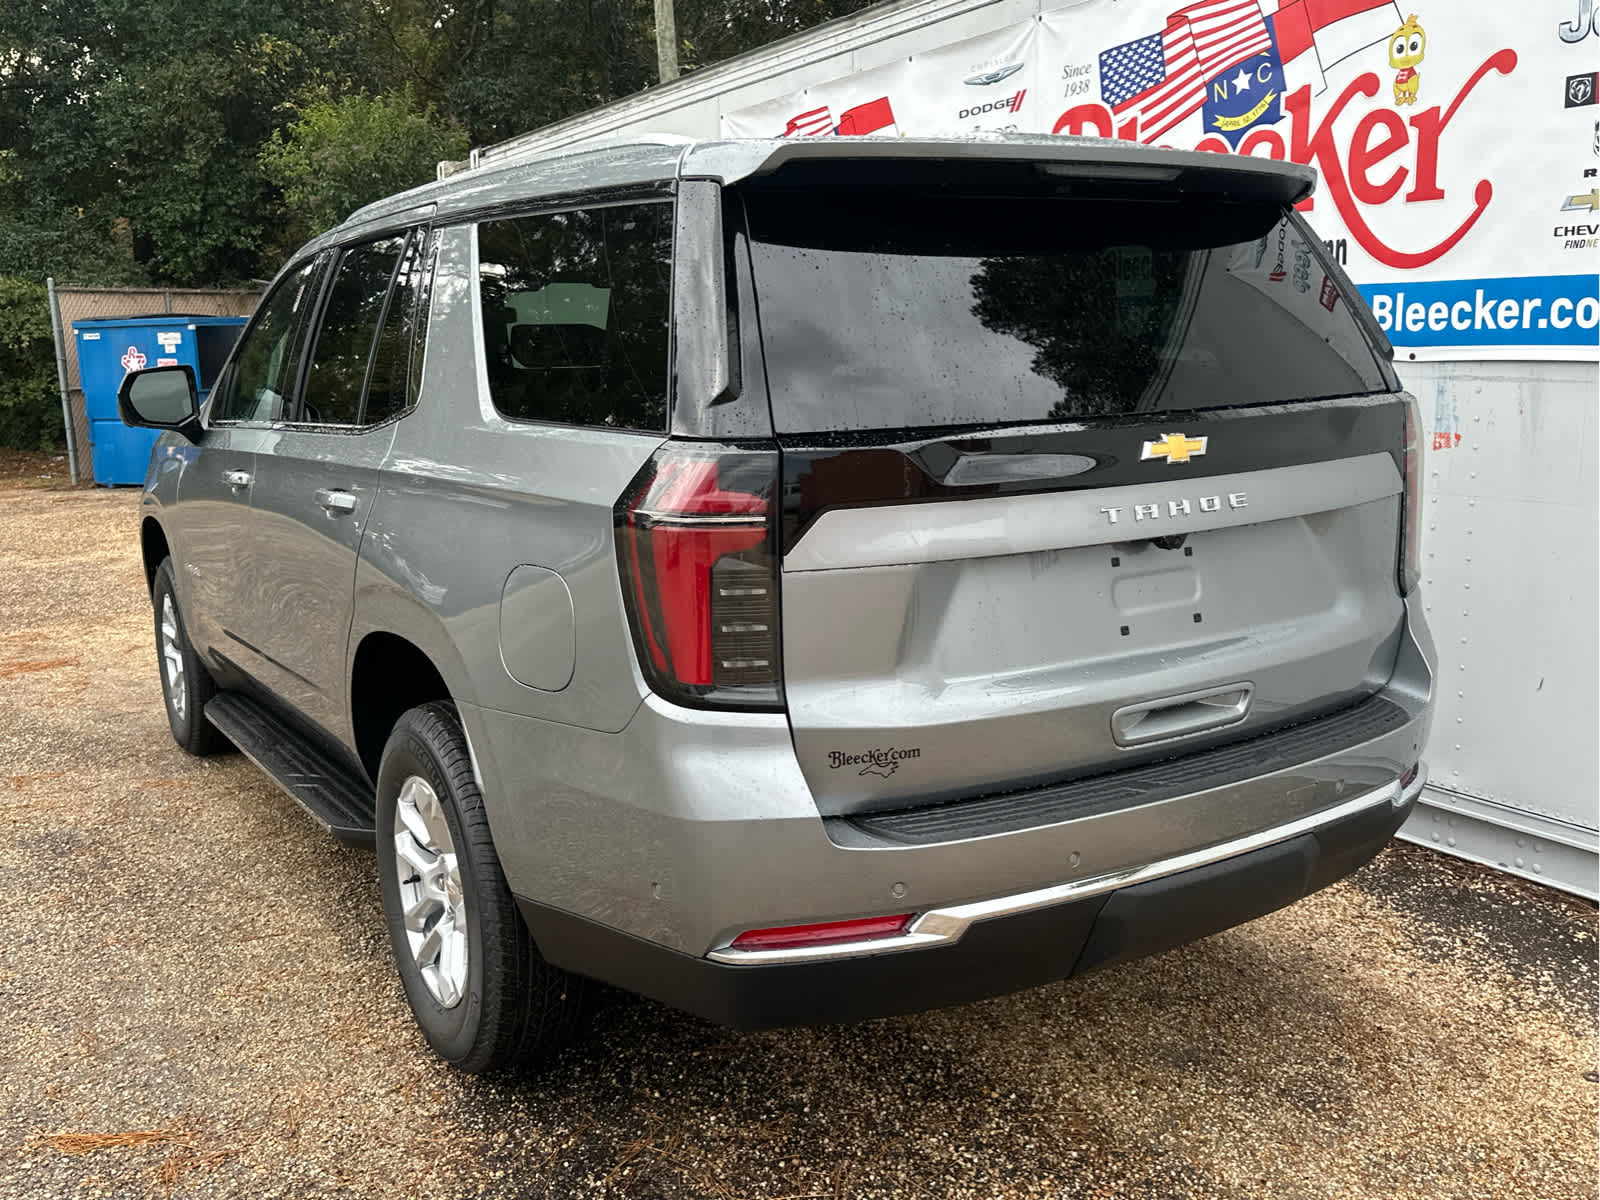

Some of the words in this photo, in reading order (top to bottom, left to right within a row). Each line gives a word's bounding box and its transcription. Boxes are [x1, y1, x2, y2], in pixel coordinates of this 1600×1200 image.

[1062, 64, 1092, 80] Since
[1214, 80, 1228, 103] N
[1257, 62, 1272, 83] C
[1063, 79, 1091, 97] 1938
[959, 96, 1016, 119] DODGE
[1100, 492, 1249, 525] TAHOE
